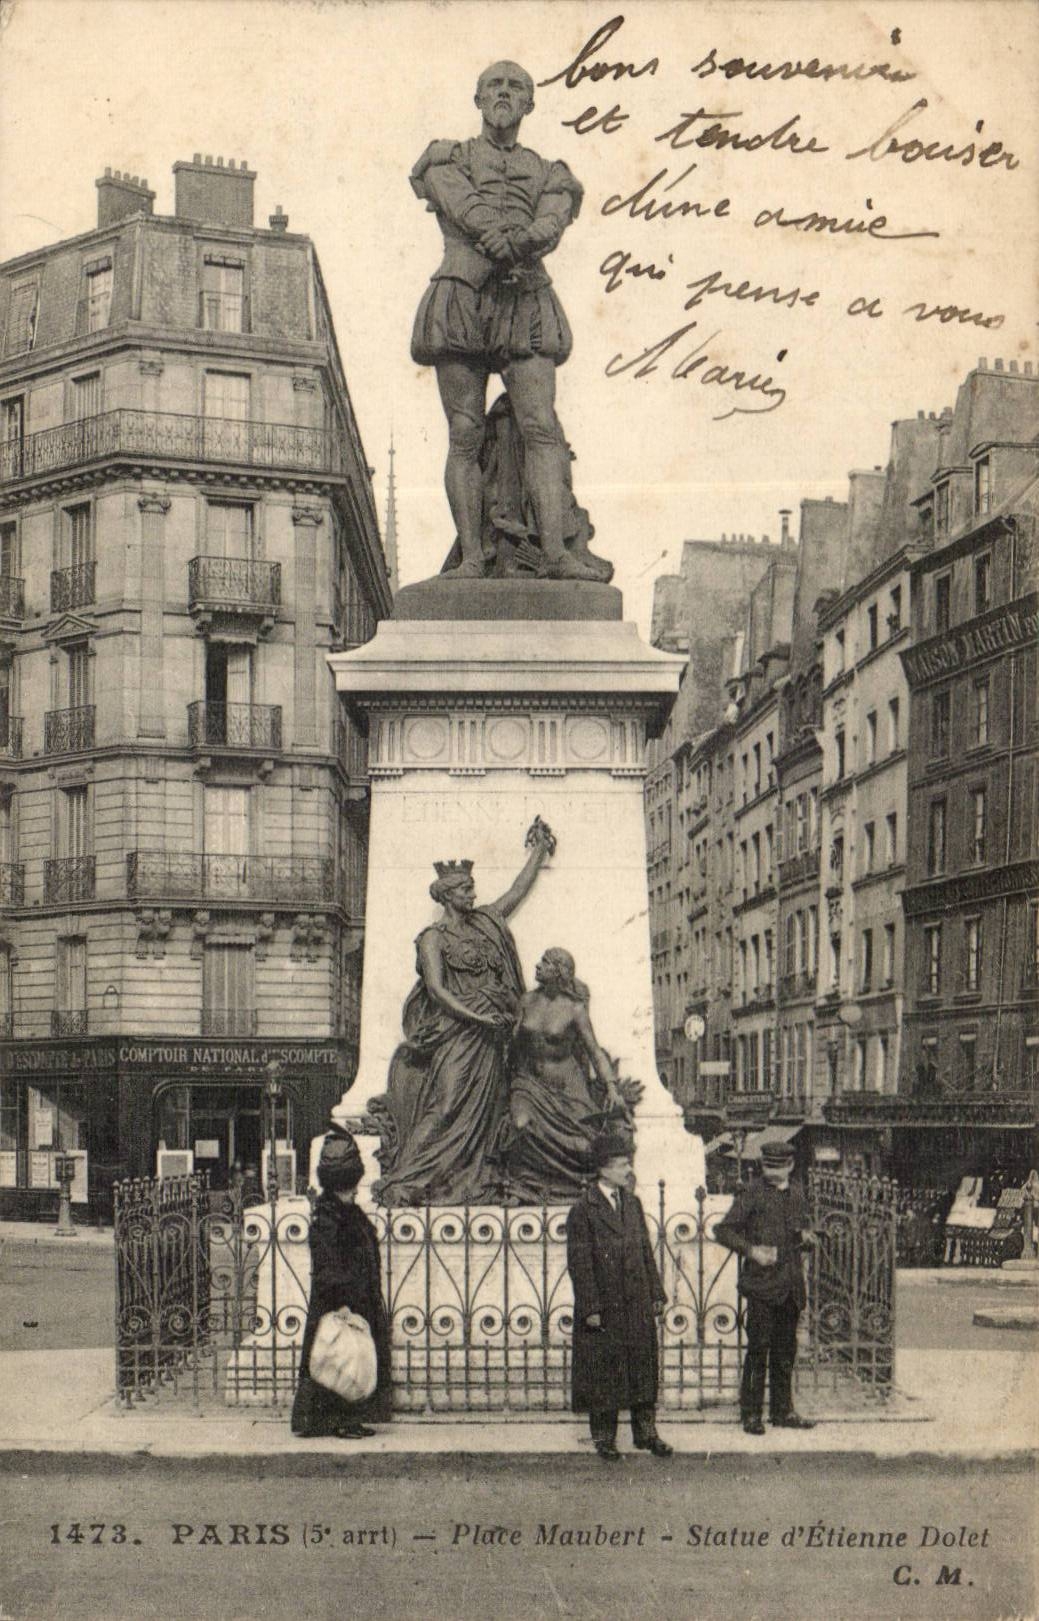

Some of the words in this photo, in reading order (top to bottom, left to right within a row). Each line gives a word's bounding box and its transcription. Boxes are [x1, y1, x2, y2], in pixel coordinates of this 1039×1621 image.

[537, 15, 658, 88] bons
[562, 104, 629, 135] et
[655, 107, 829, 152] tendre
[601, 163, 731, 219] d'une
[754, 198, 940, 239] amie
[600, 249, 674, 294] qui
[685, 270, 820, 311] pense
[903, 304, 1005, 330] vous
[119, 1048, 188, 1064] COMPTOIR
[193, 1048, 260, 1063] NATIONAL
